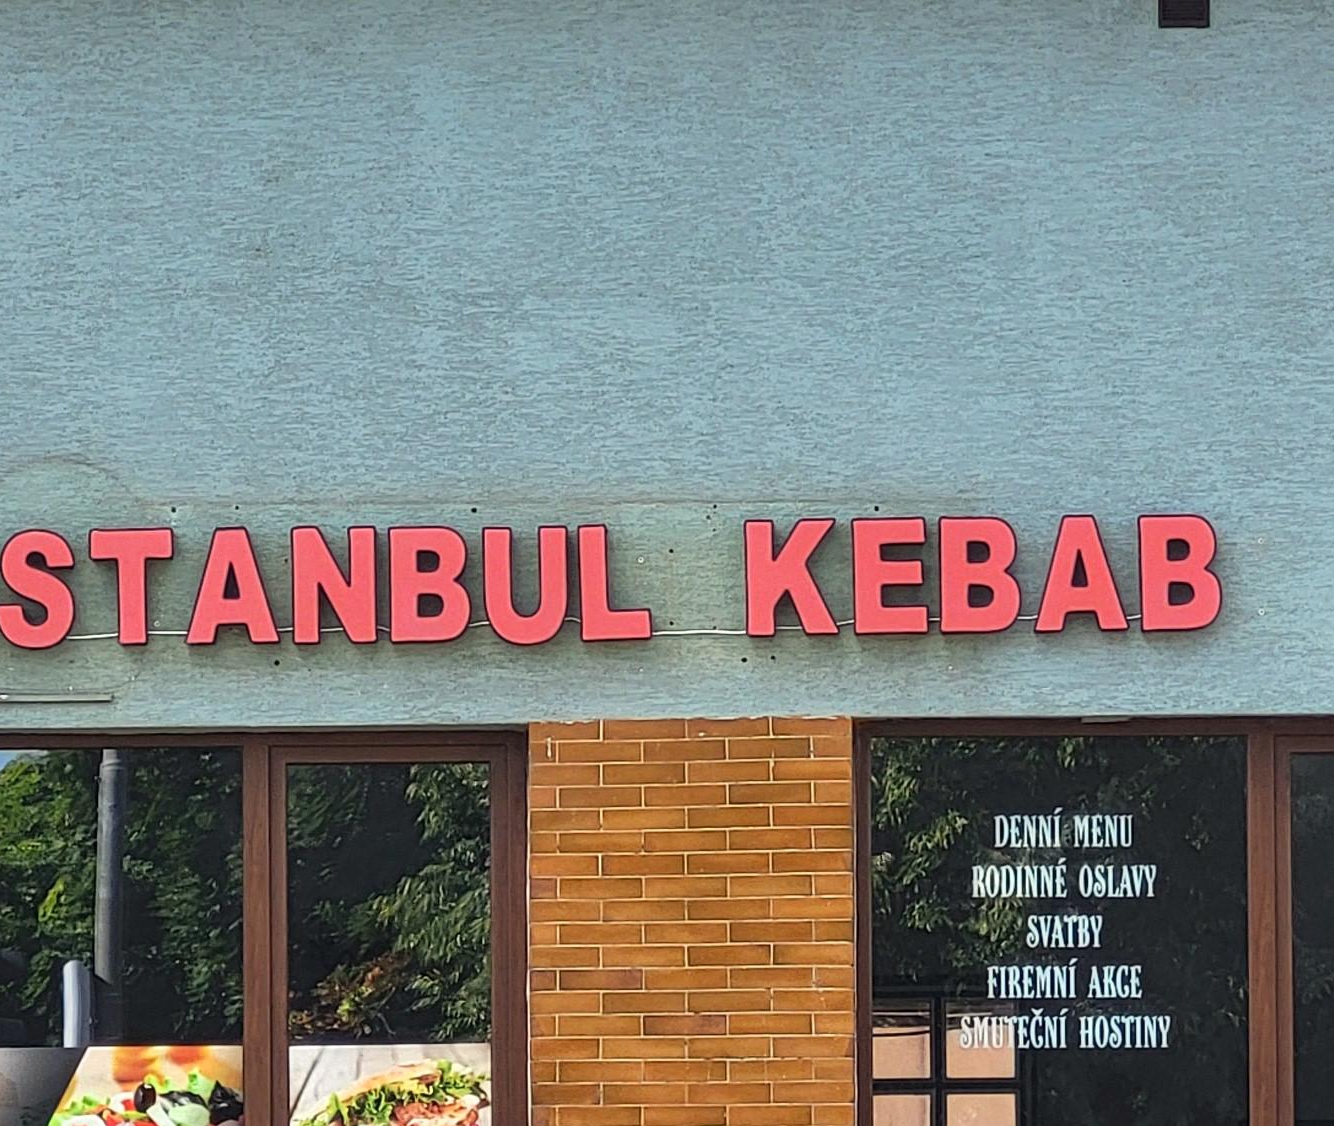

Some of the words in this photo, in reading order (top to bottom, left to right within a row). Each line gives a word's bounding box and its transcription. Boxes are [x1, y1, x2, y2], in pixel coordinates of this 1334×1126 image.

[742, 514, 1224, 635] KEBAB
[994, 807, 1061, 848] DENNÍ
[1073, 814, 1133, 848] MENU
[971, 859, 1067, 898] RODINNÉ
[1078, 864, 1157, 898] OSLAVY
[1026, 914, 1103, 948] SVATBY
[987, 957, 1077, 999] FIREMNÍ
[1087, 965, 1143, 999] AKCE
[959, 1008, 1067, 1049] SMUTEČNÍ
[1079, 1015, 1171, 1049] HOSTINY
